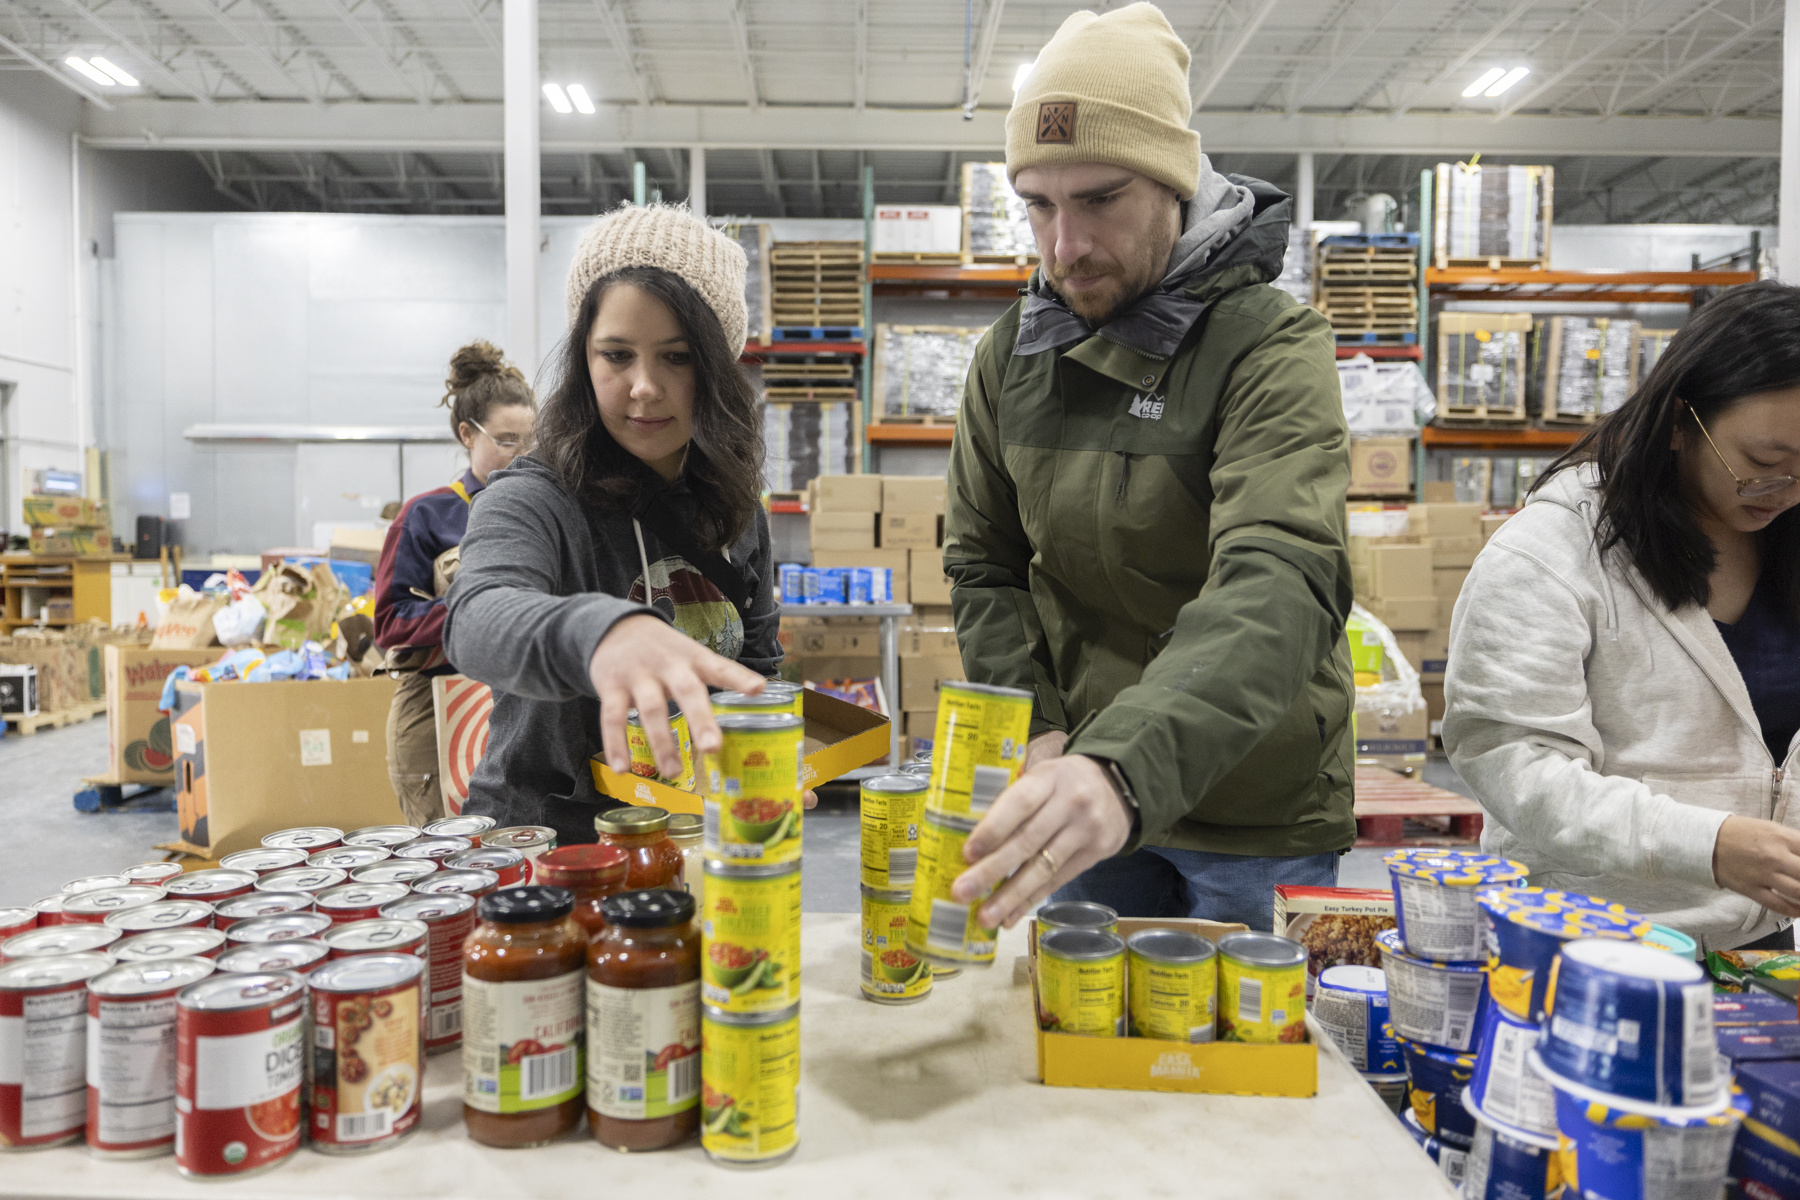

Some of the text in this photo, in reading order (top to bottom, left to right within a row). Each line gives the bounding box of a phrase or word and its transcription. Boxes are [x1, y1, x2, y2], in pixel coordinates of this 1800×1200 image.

[1043, 114, 1069, 124] M N
[1141, 400, 1165, 414] REI
[631, 745, 653, 756] TOMAT
[803, 770, 818, 782] MITA
[1324, 905, 1340, 913] Easy
[265, 1039, 302, 1072] DICE
